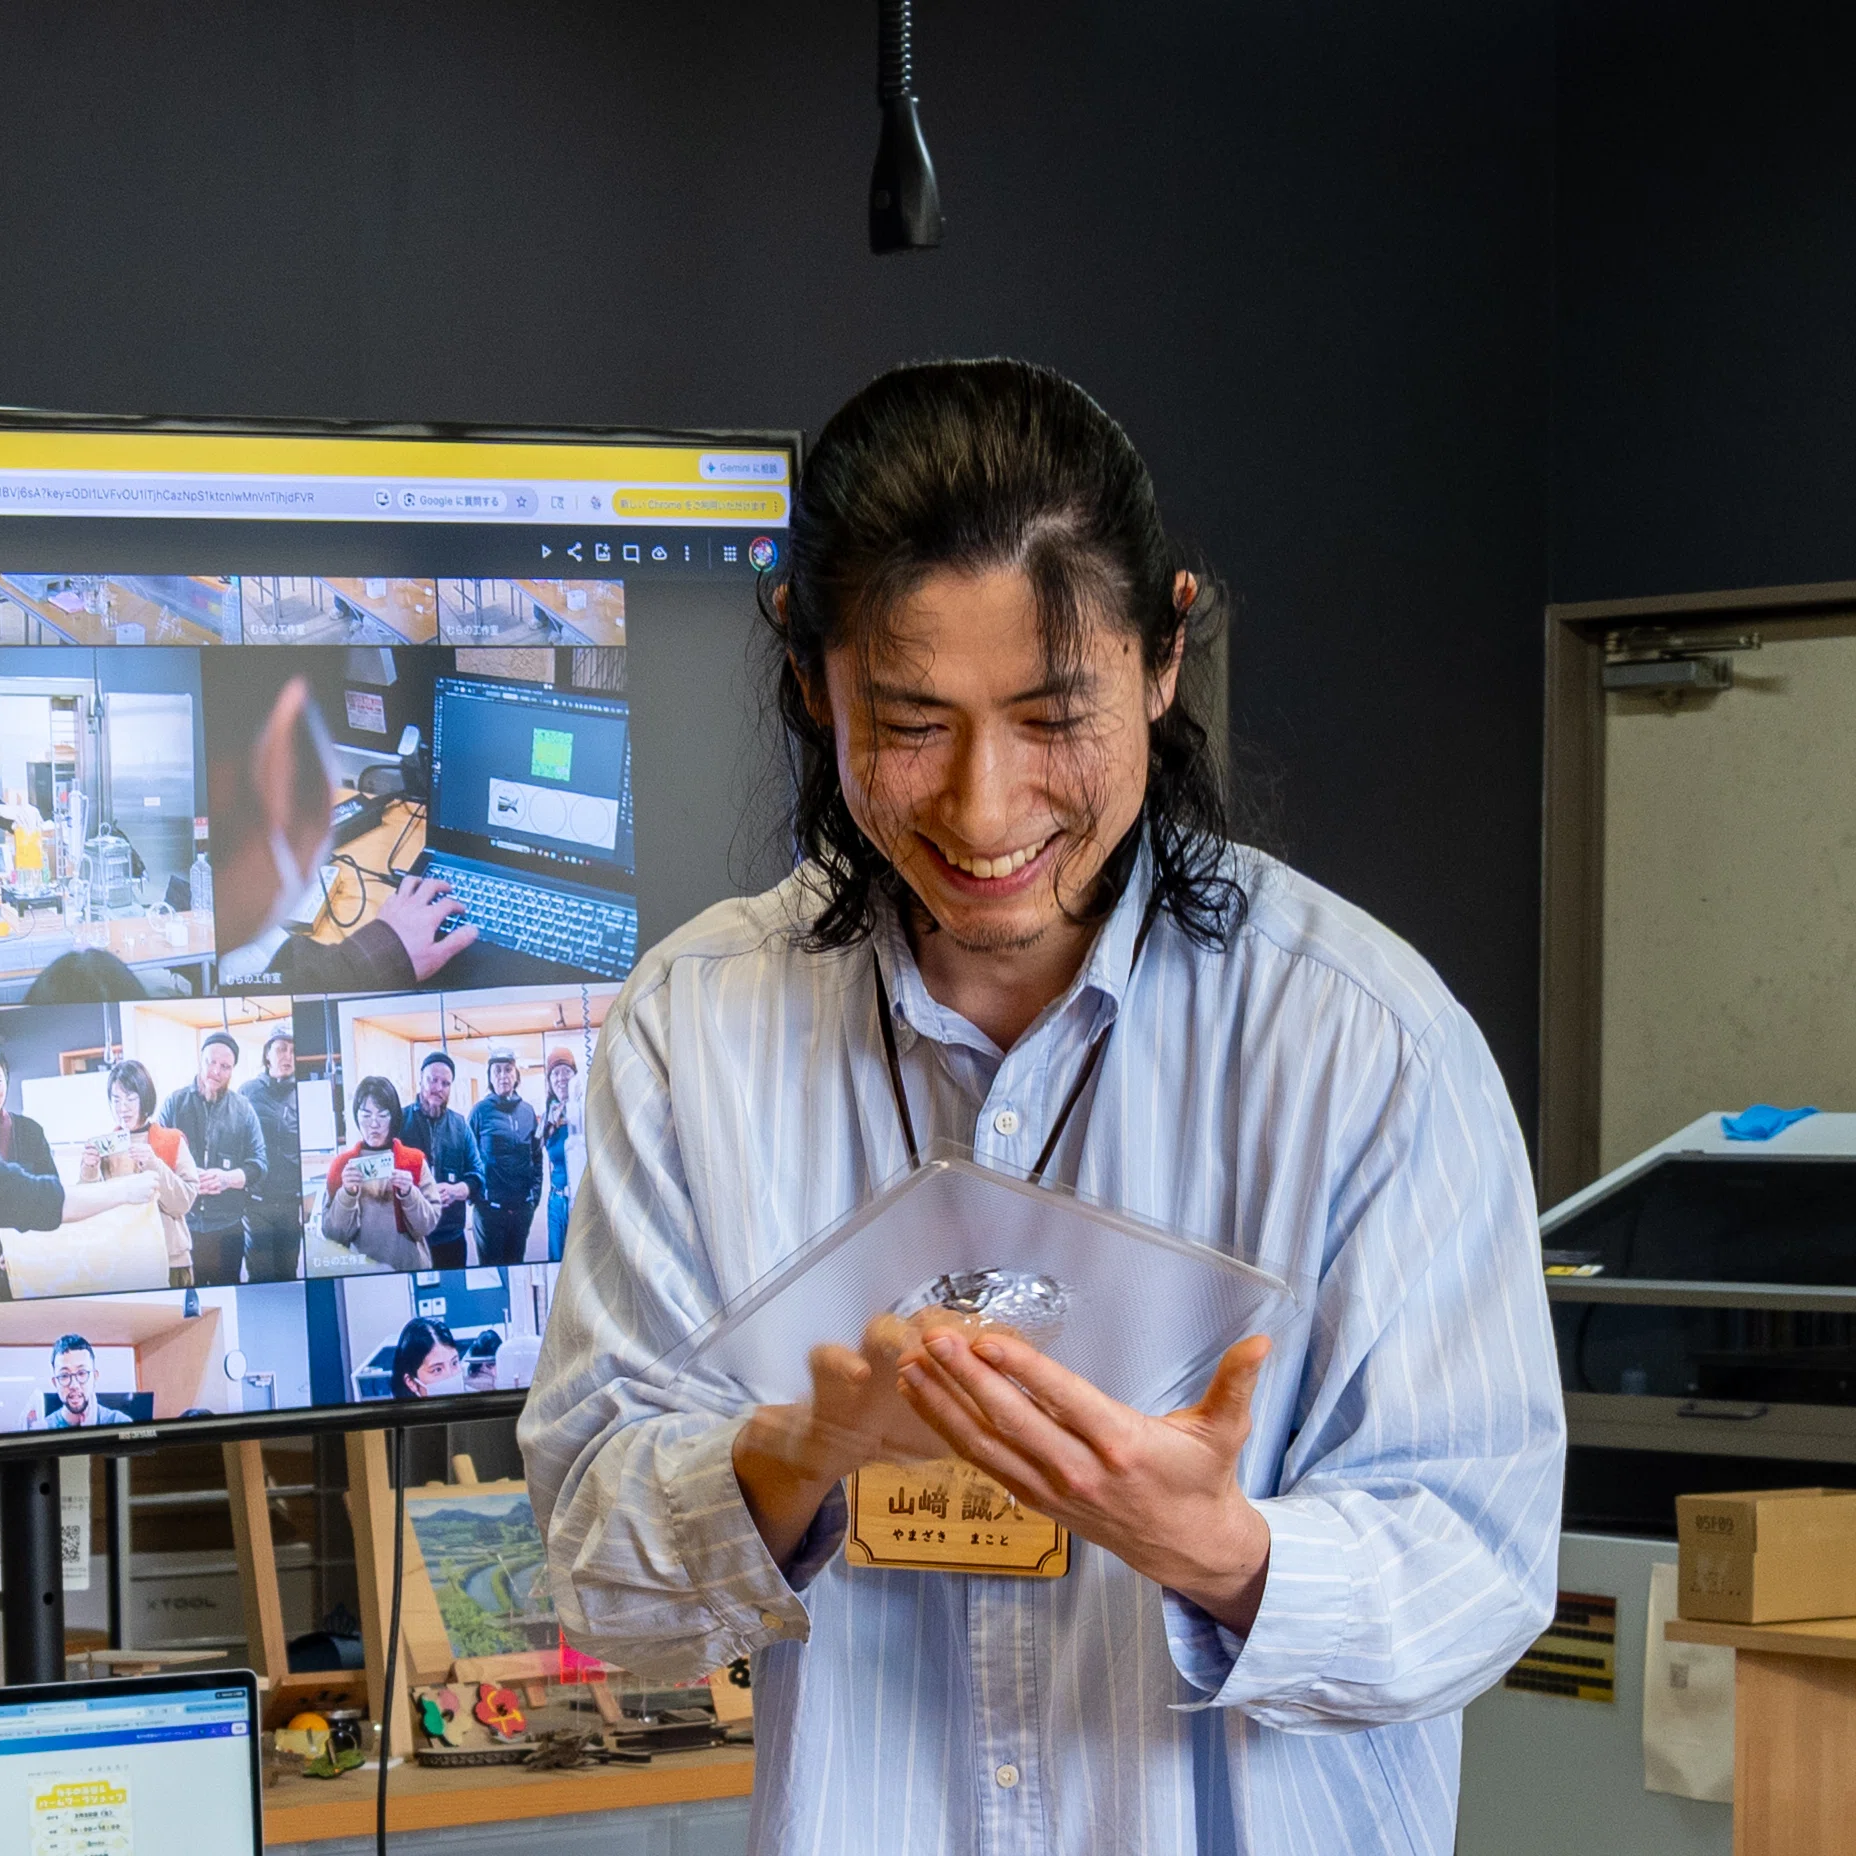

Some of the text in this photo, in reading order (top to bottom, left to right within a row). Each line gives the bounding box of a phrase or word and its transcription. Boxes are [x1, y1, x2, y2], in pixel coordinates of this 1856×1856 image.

[419, 494, 453, 508] Google
[892, 1528, 1009, 1546] やまざき まこと
